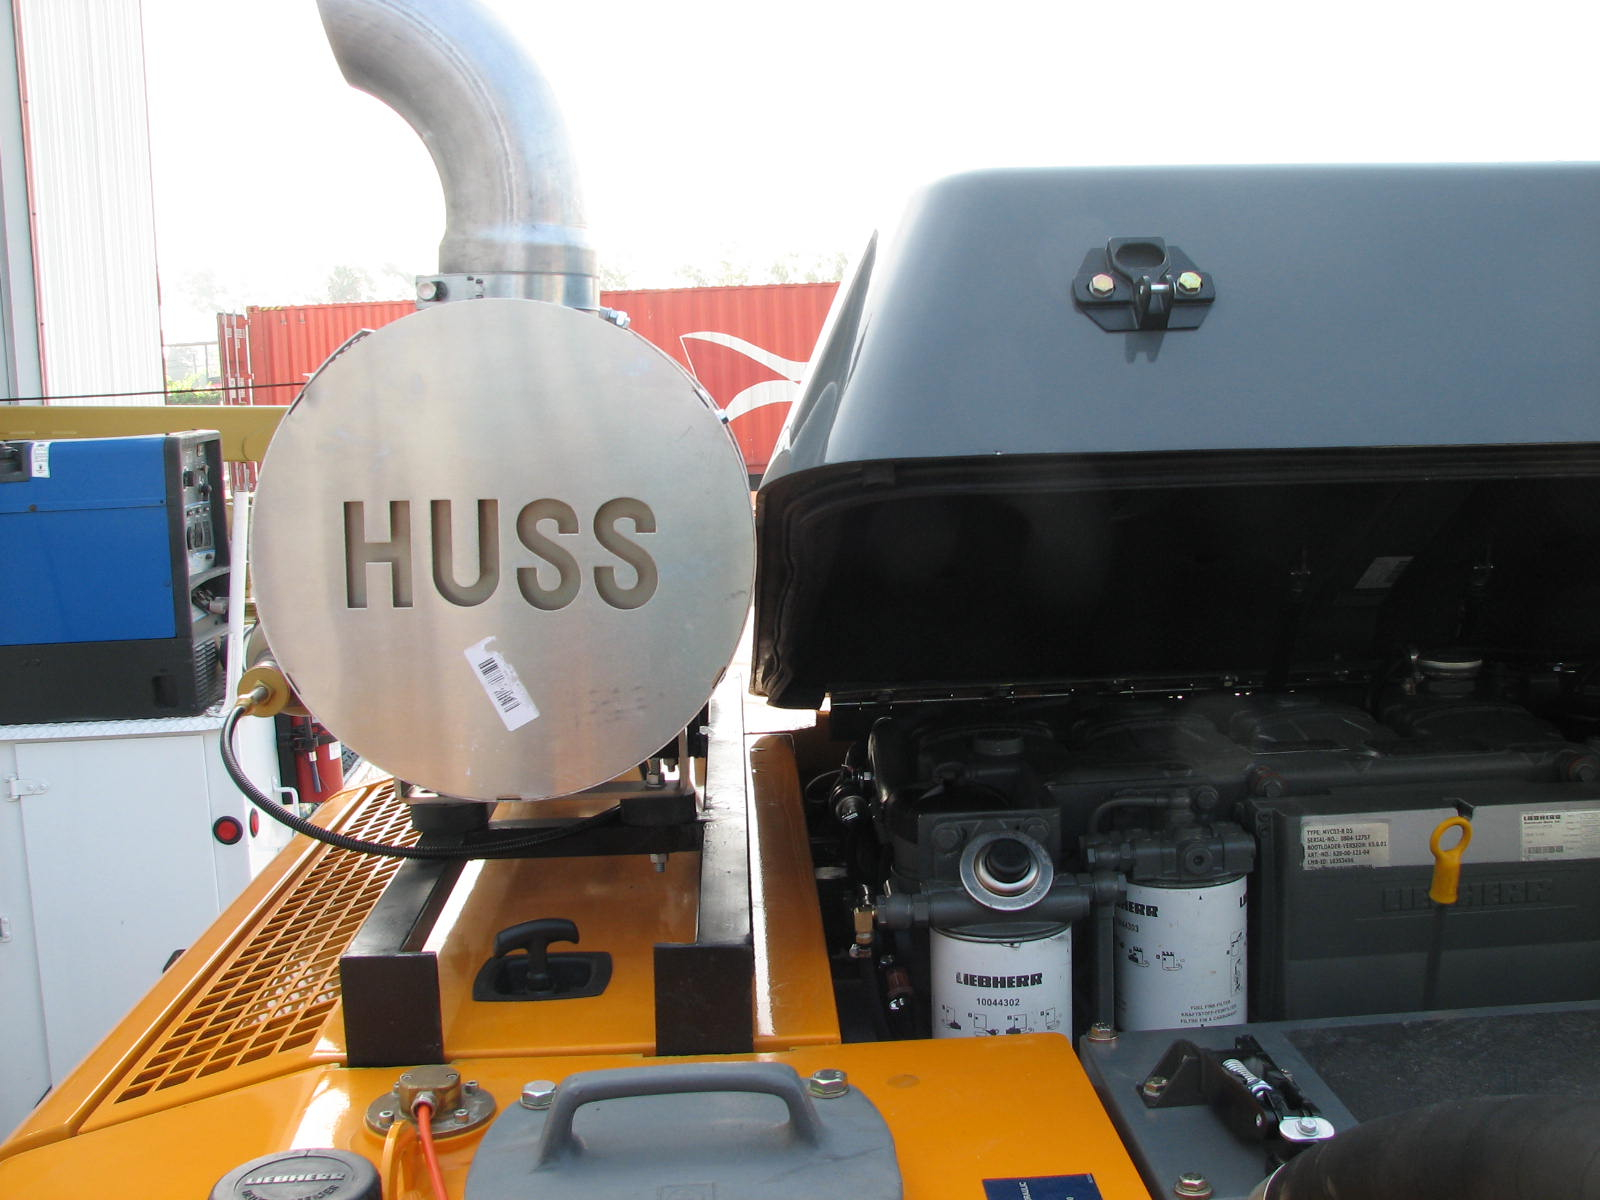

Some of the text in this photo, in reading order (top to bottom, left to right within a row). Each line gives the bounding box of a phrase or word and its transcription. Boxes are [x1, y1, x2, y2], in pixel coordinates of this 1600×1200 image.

[344, 497, 658, 611] HUSS
[956, 972, 1042, 988] LIEBHERR
[976, 998, 1020, 1006] 10044302
[245, 1173, 346, 1186] LIEBHERR
